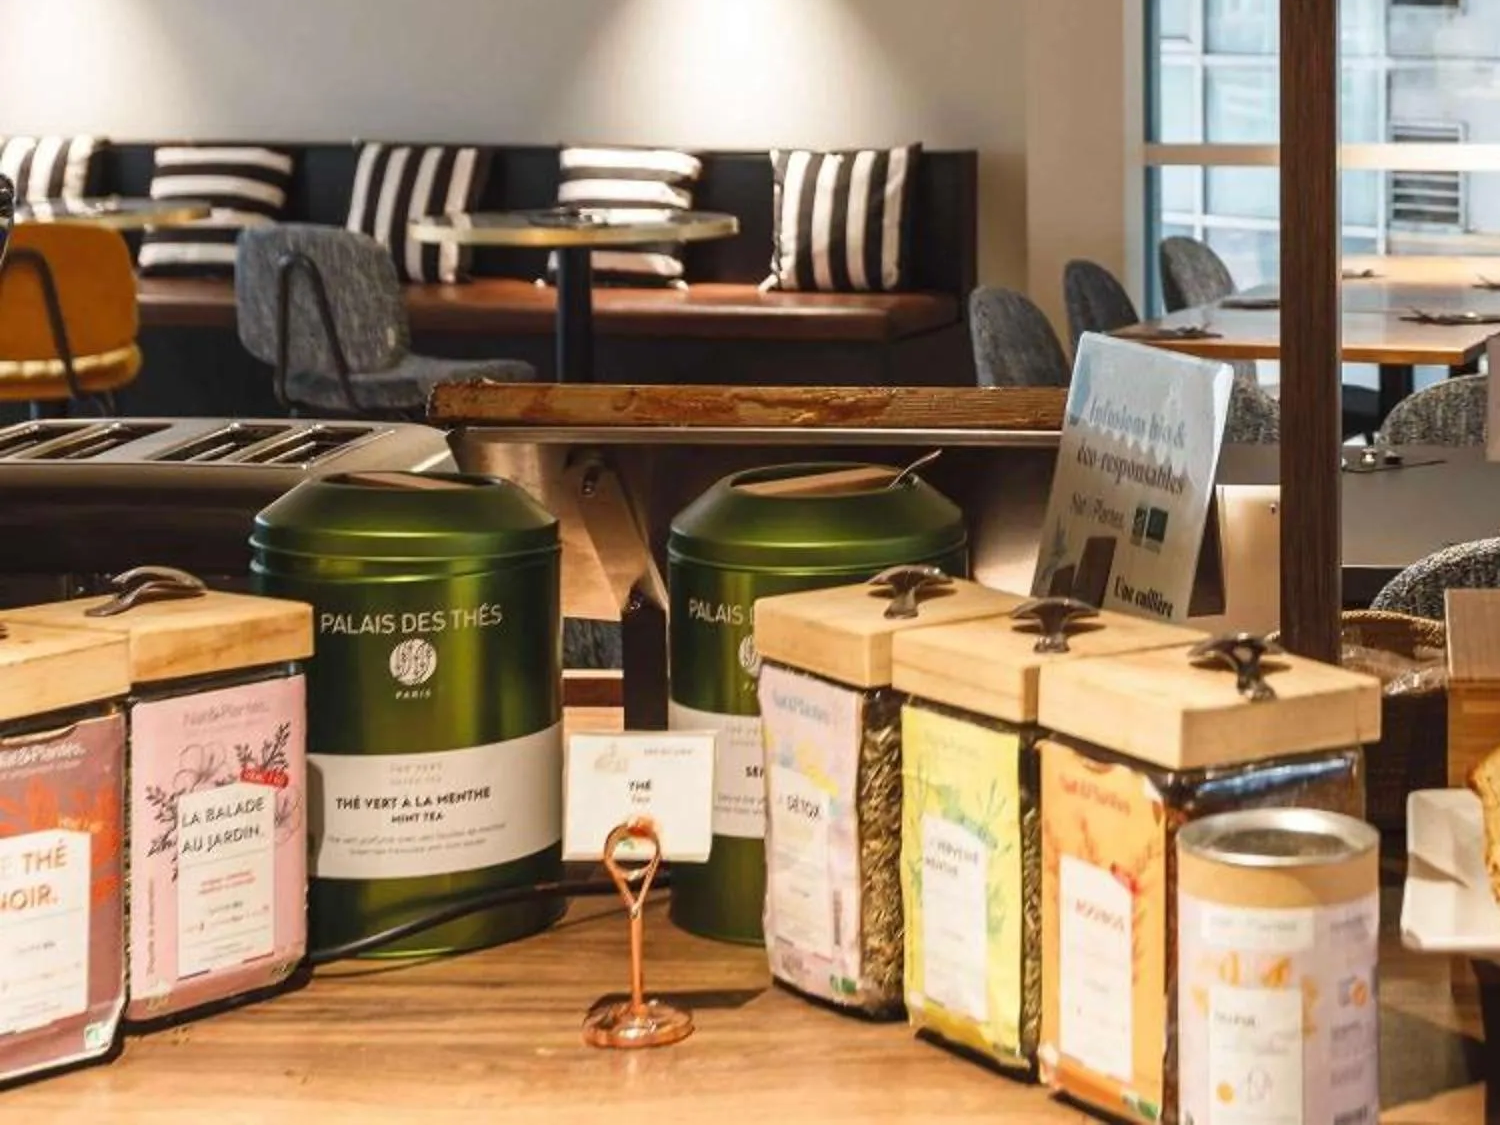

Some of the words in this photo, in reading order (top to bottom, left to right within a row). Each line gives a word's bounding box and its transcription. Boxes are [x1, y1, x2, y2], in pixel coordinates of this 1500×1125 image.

[320, 612, 395, 635] PALAIS
[401, 610, 446, 633] DES
[451, 604, 503, 629] THÉS
[689, 598, 745, 625] PALAIS
[395, 689, 432, 700] PARIS
[335, 794, 361, 810] THÉ
[364, 797, 399, 810] VERT
[415, 794, 433, 808] LA
[437, 786, 491, 804] MENTHE
[182, 810, 200, 828] LA
[206, 796, 265, 823] BALADE
[391, 812, 419, 824] MINT
[422, 811, 443, 823] TEA
[22, 838, 68, 874] THÉ
[182, 835, 203, 853] AU
